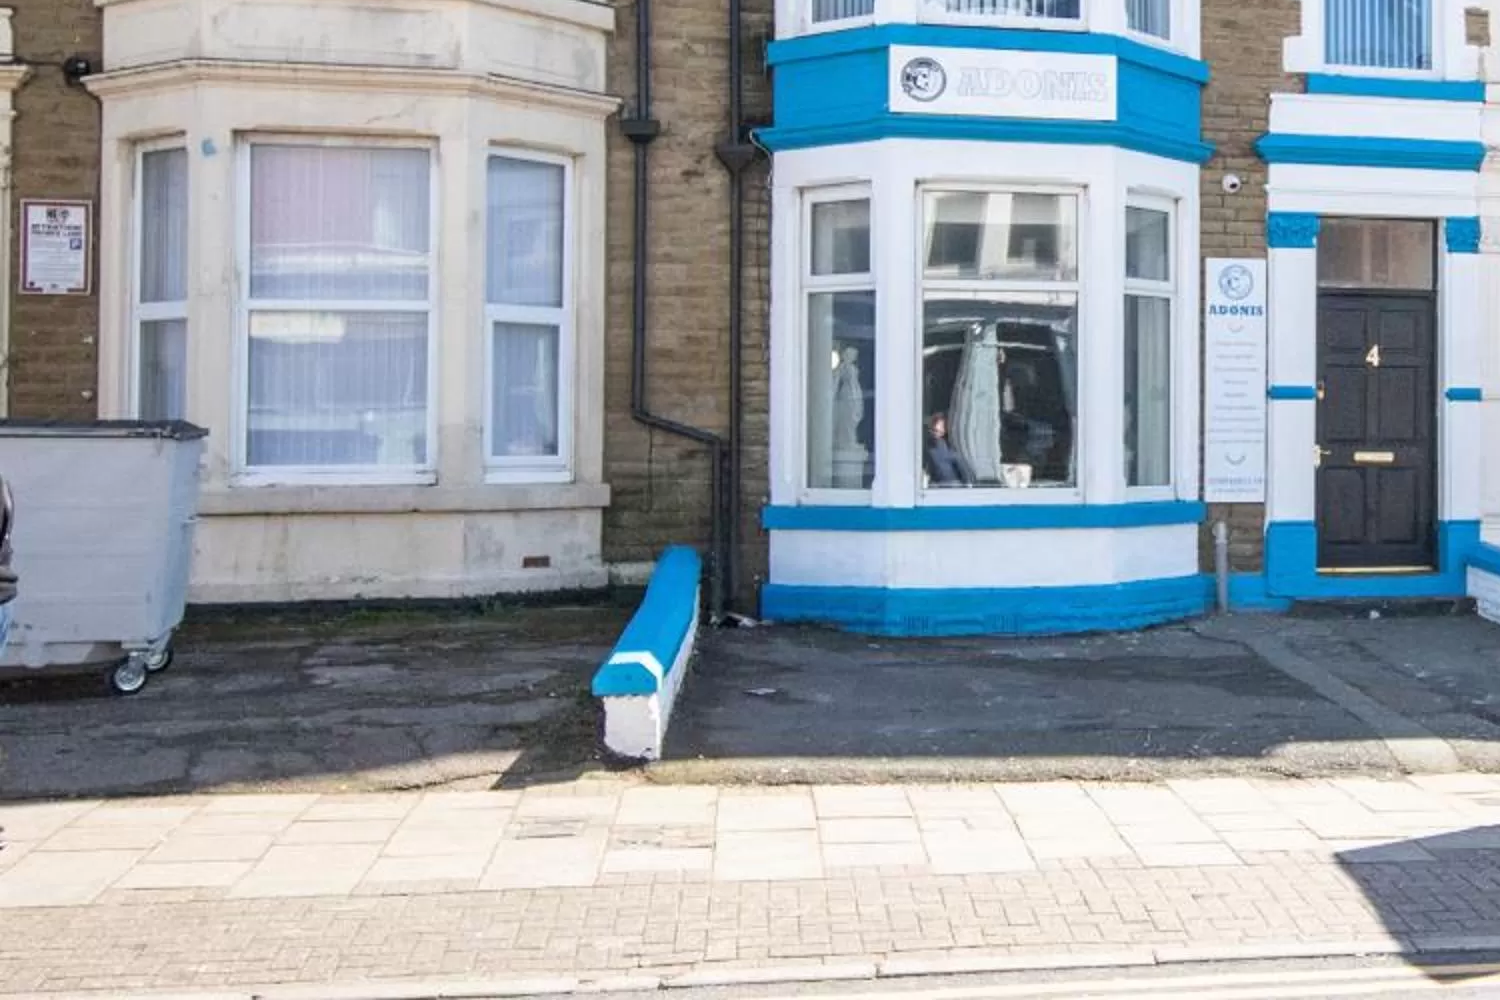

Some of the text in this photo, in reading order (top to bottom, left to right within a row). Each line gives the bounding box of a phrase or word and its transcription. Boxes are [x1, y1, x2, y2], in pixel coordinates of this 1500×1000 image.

[957, 66, 1109, 104] ADONIS
[1208, 304, 1264, 317] ADONIS
[1365, 343, 1380, 367] 4
